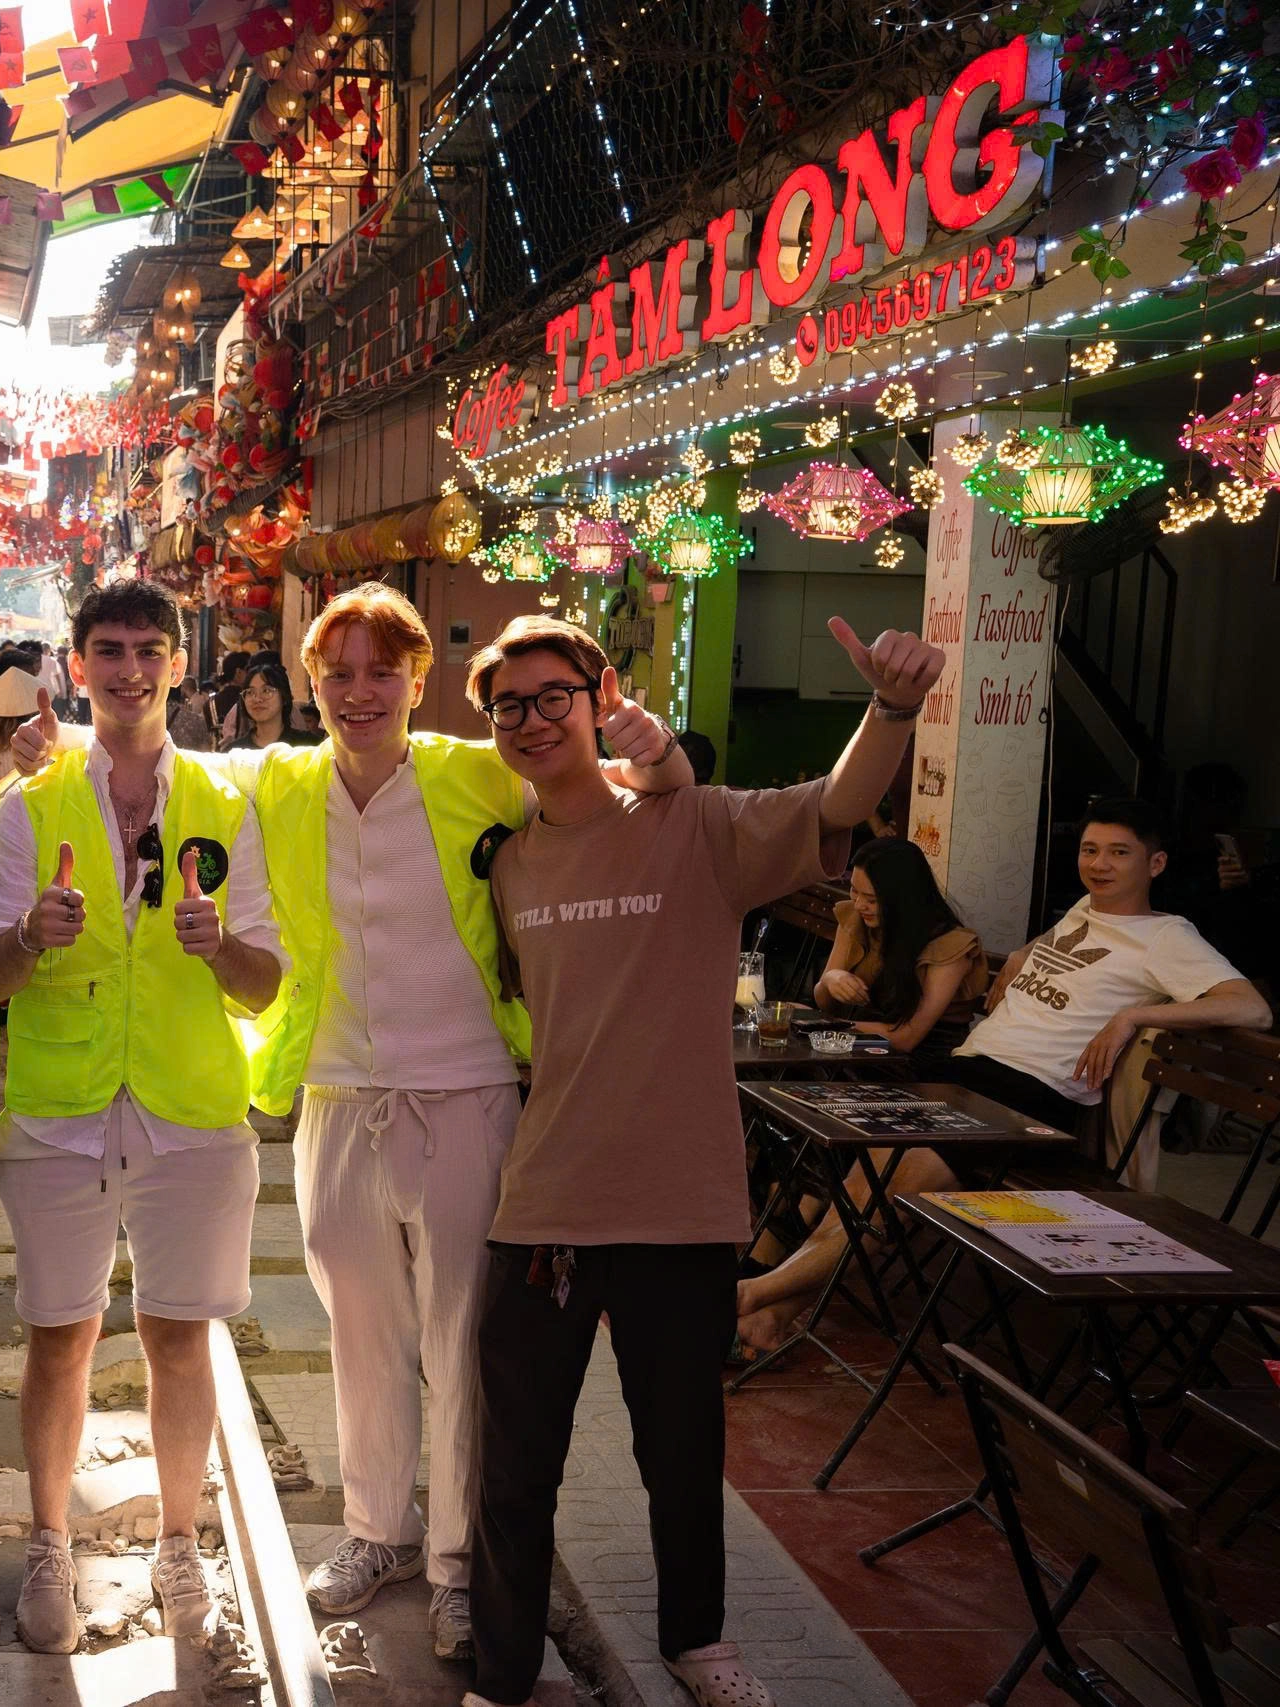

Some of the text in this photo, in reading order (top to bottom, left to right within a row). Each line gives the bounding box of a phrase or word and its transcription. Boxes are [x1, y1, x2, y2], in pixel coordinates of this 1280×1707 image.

[545, 34, 1043, 407] TÂM LONG
[824, 235, 1017, 353] 0945697123
[453, 362, 525, 460] Coffee
[936, 508, 963, 579] Coffee
[926, 591, 964, 648] Fastfood
[973, 589, 1049, 660] Fastfood
[942, 671, 957, 725] tố
[975, 670, 1037, 726] Sinh tố
[558, 898, 614, 922] WITH
[618, 892, 663, 916] YOU
[1010, 971, 1070, 1011] adidas
